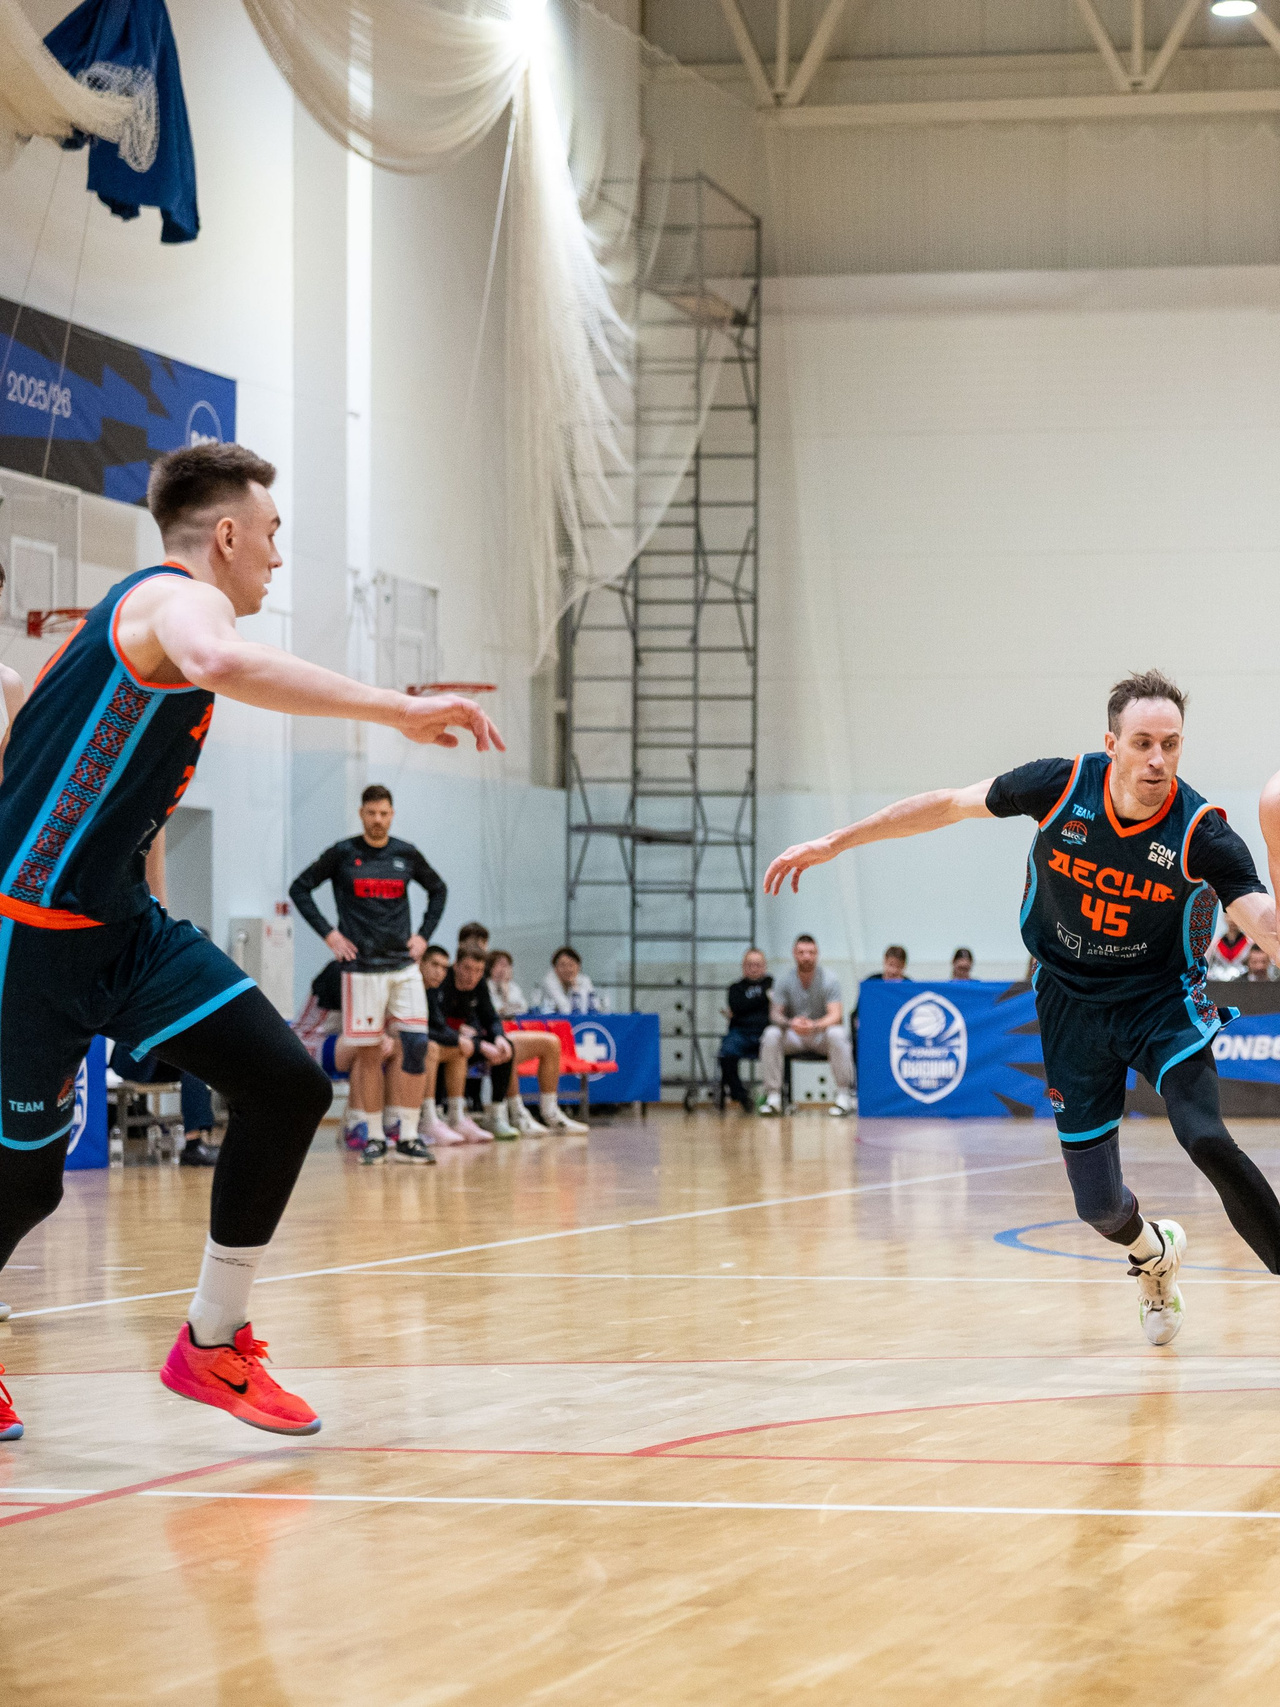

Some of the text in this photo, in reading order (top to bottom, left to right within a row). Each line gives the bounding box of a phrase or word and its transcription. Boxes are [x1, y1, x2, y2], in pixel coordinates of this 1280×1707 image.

[1072, 803, 1096, 821] TEAM
[1147, 851, 1175, 870] BET
[1149, 841, 1177, 861] FON
[1080, 894, 1131, 937] 45
[9, 1100, 45, 1112] TEAM
